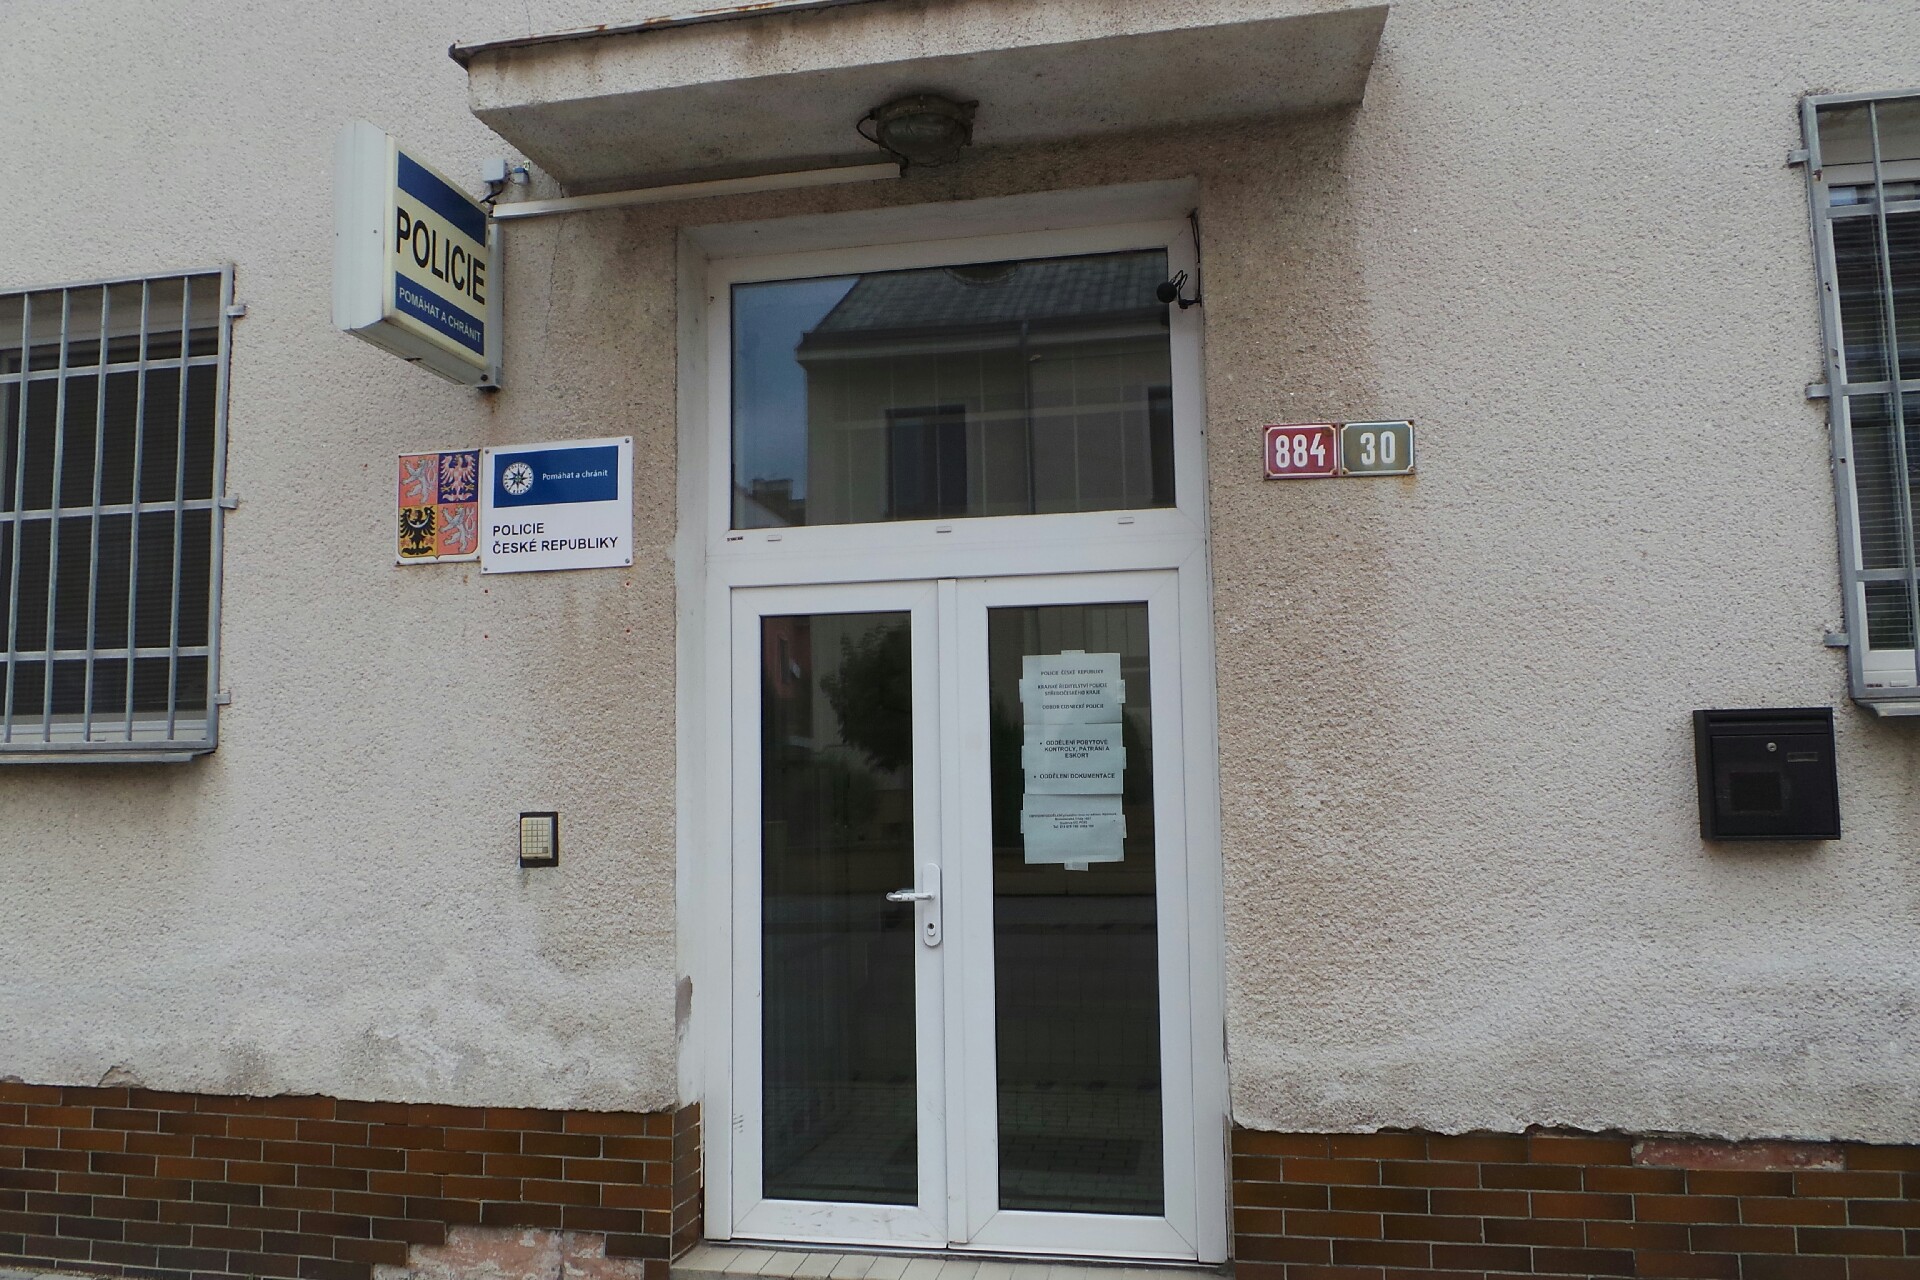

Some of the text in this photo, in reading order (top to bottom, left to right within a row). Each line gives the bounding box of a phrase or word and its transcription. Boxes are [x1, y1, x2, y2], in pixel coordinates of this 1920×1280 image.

[397, 206, 485, 305] POLICIE
[399, 287, 480, 342] POMÁHAT A CHRÁNIT
[1275, 433, 1326, 469] 884
[1360, 431, 1396, 465] 30
[542, 471, 574, 481] Pomáhat
[581, 469, 608, 478] chránit
[492, 536, 618, 555] ČESKÉ REPUBLIKY
[493, 522, 545, 537] POLICIE
